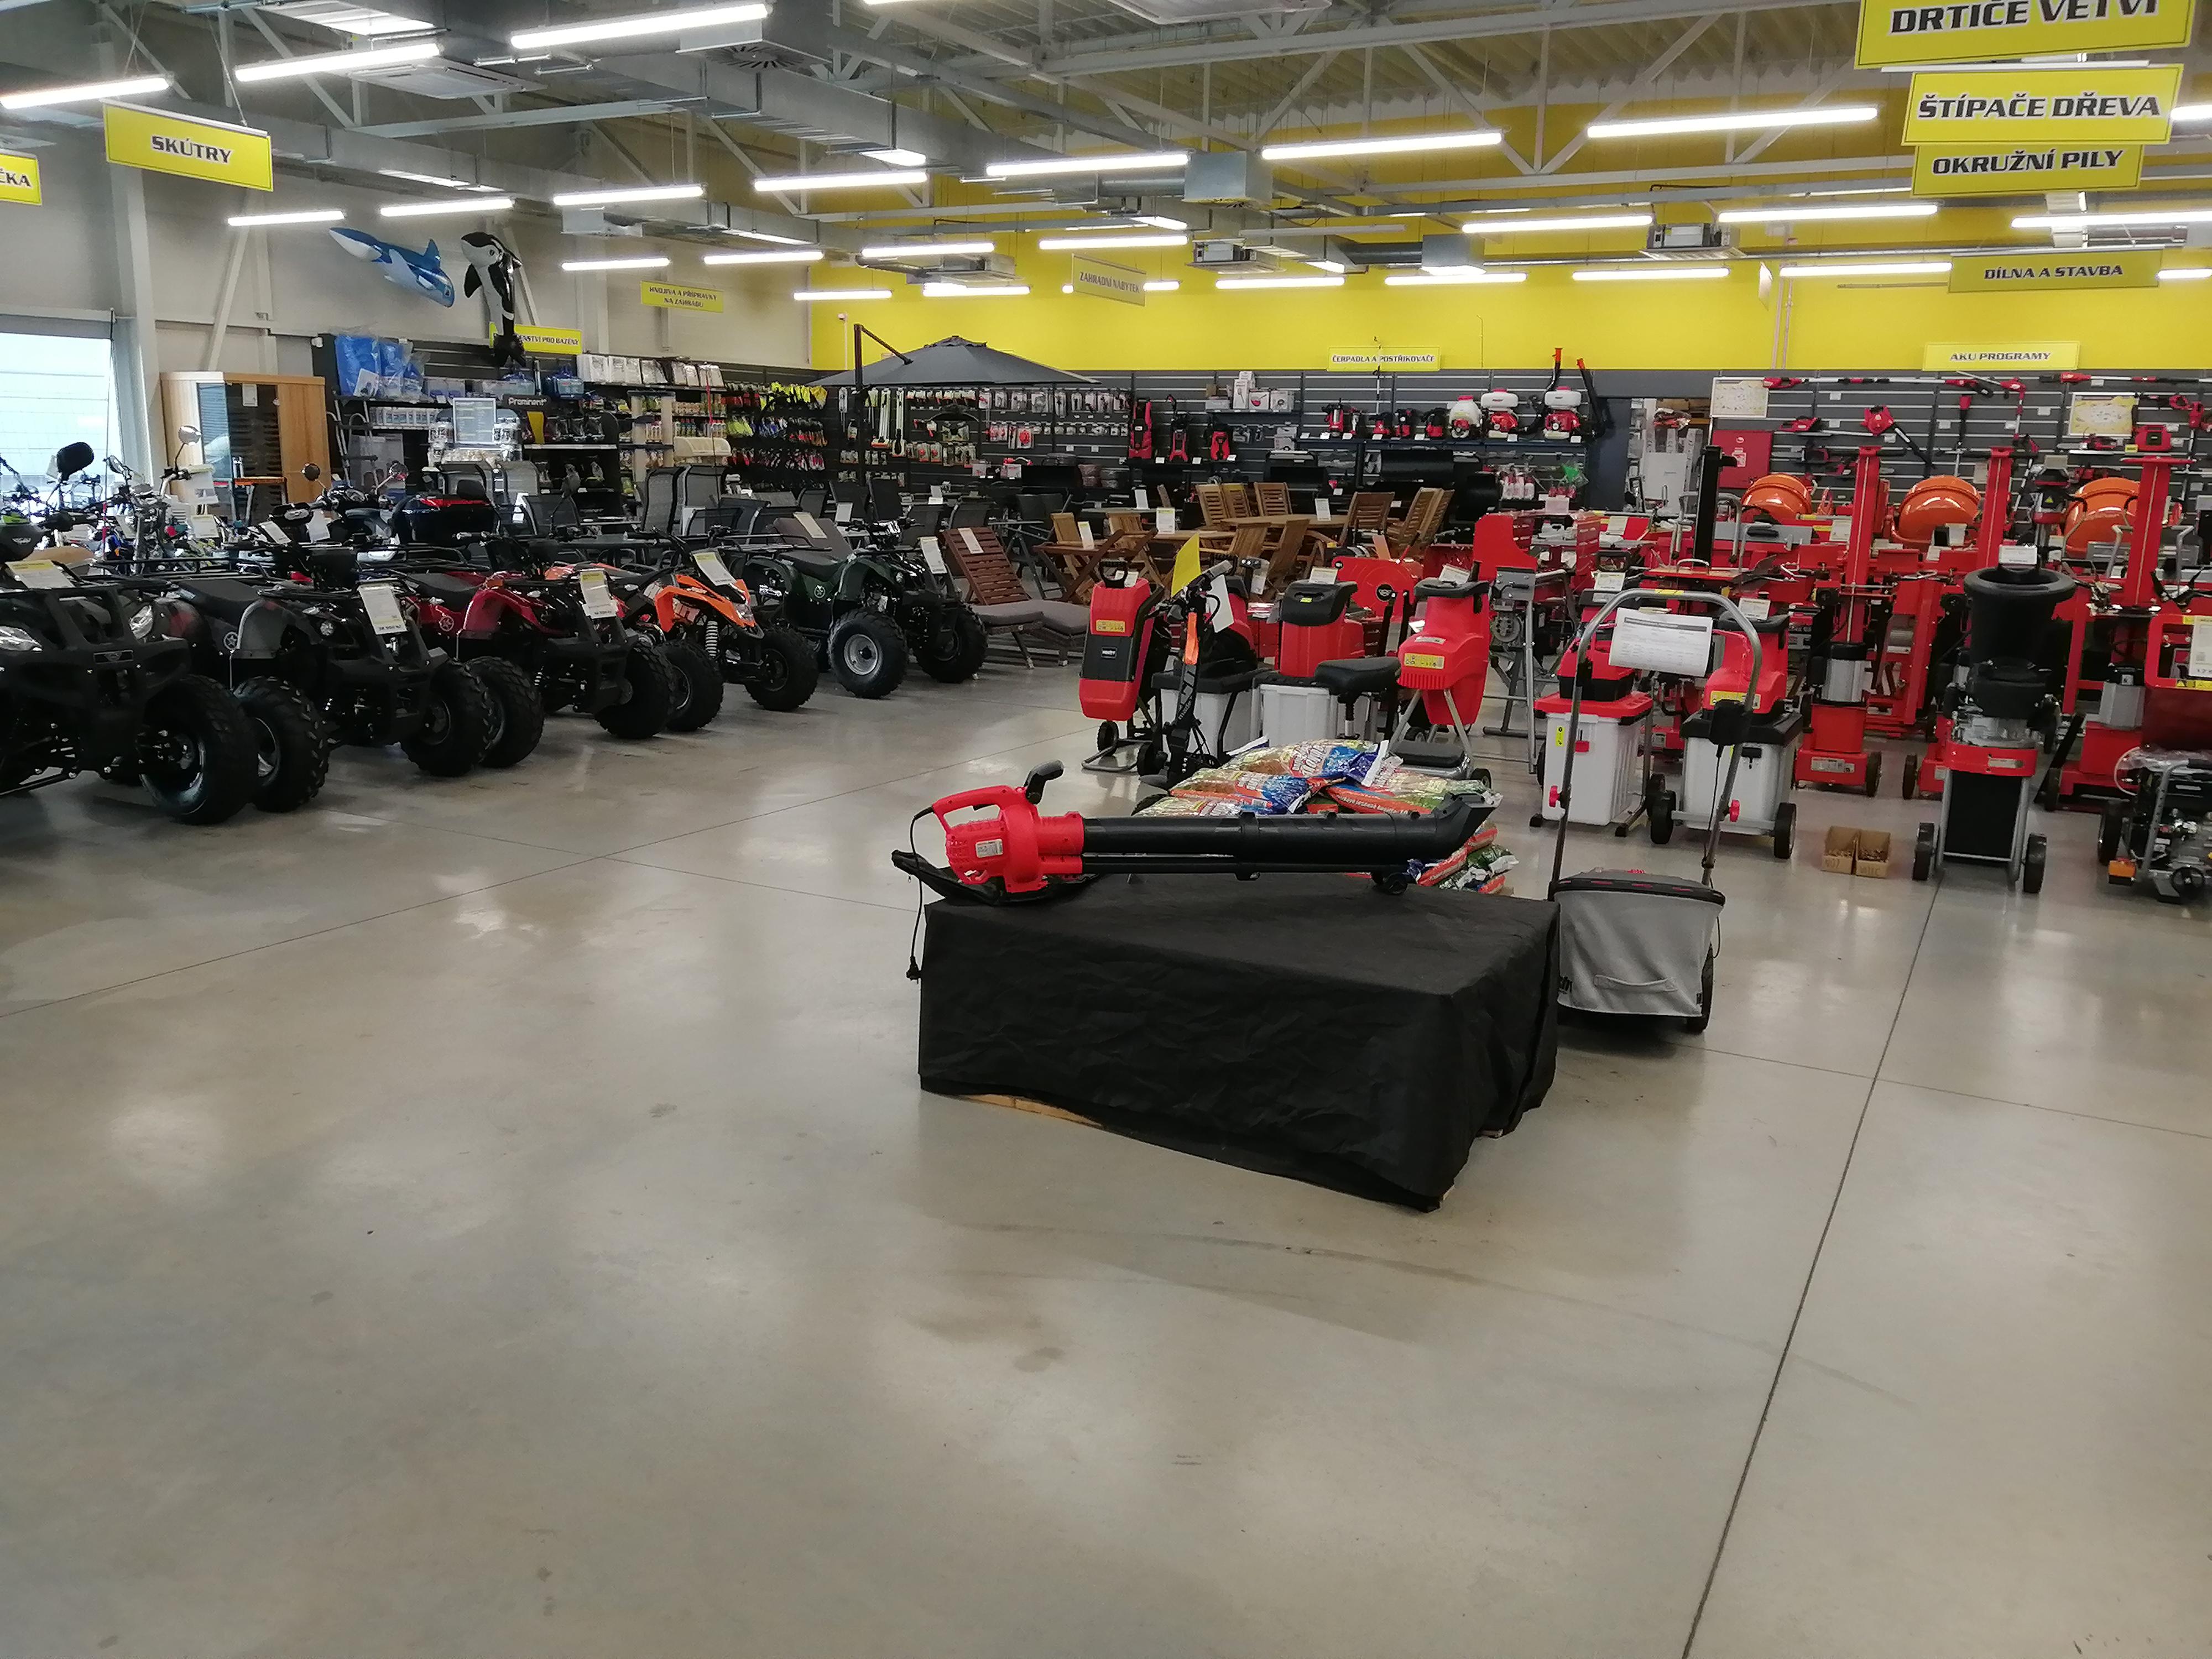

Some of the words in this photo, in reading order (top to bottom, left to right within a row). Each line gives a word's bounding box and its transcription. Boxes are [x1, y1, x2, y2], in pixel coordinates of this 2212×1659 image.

[1918, 92, 2046, 118] ŠTÍPAČE
[2052, 92, 2160, 116] DŘEVA
[152, 136, 232, 164] SKÚTRY
[1932, 149, 2056, 174] OKRUŽNÍ
[2062, 150, 2125, 169] PILY
[1984, 267, 2035, 279] DÍLNA
[2038, 268, 2051, 278] A
[2054, 265, 2124, 277] STAVBA
[1950, 352, 1977, 361] AKU
[1979, 352, 2052, 360] PROGRAMY
